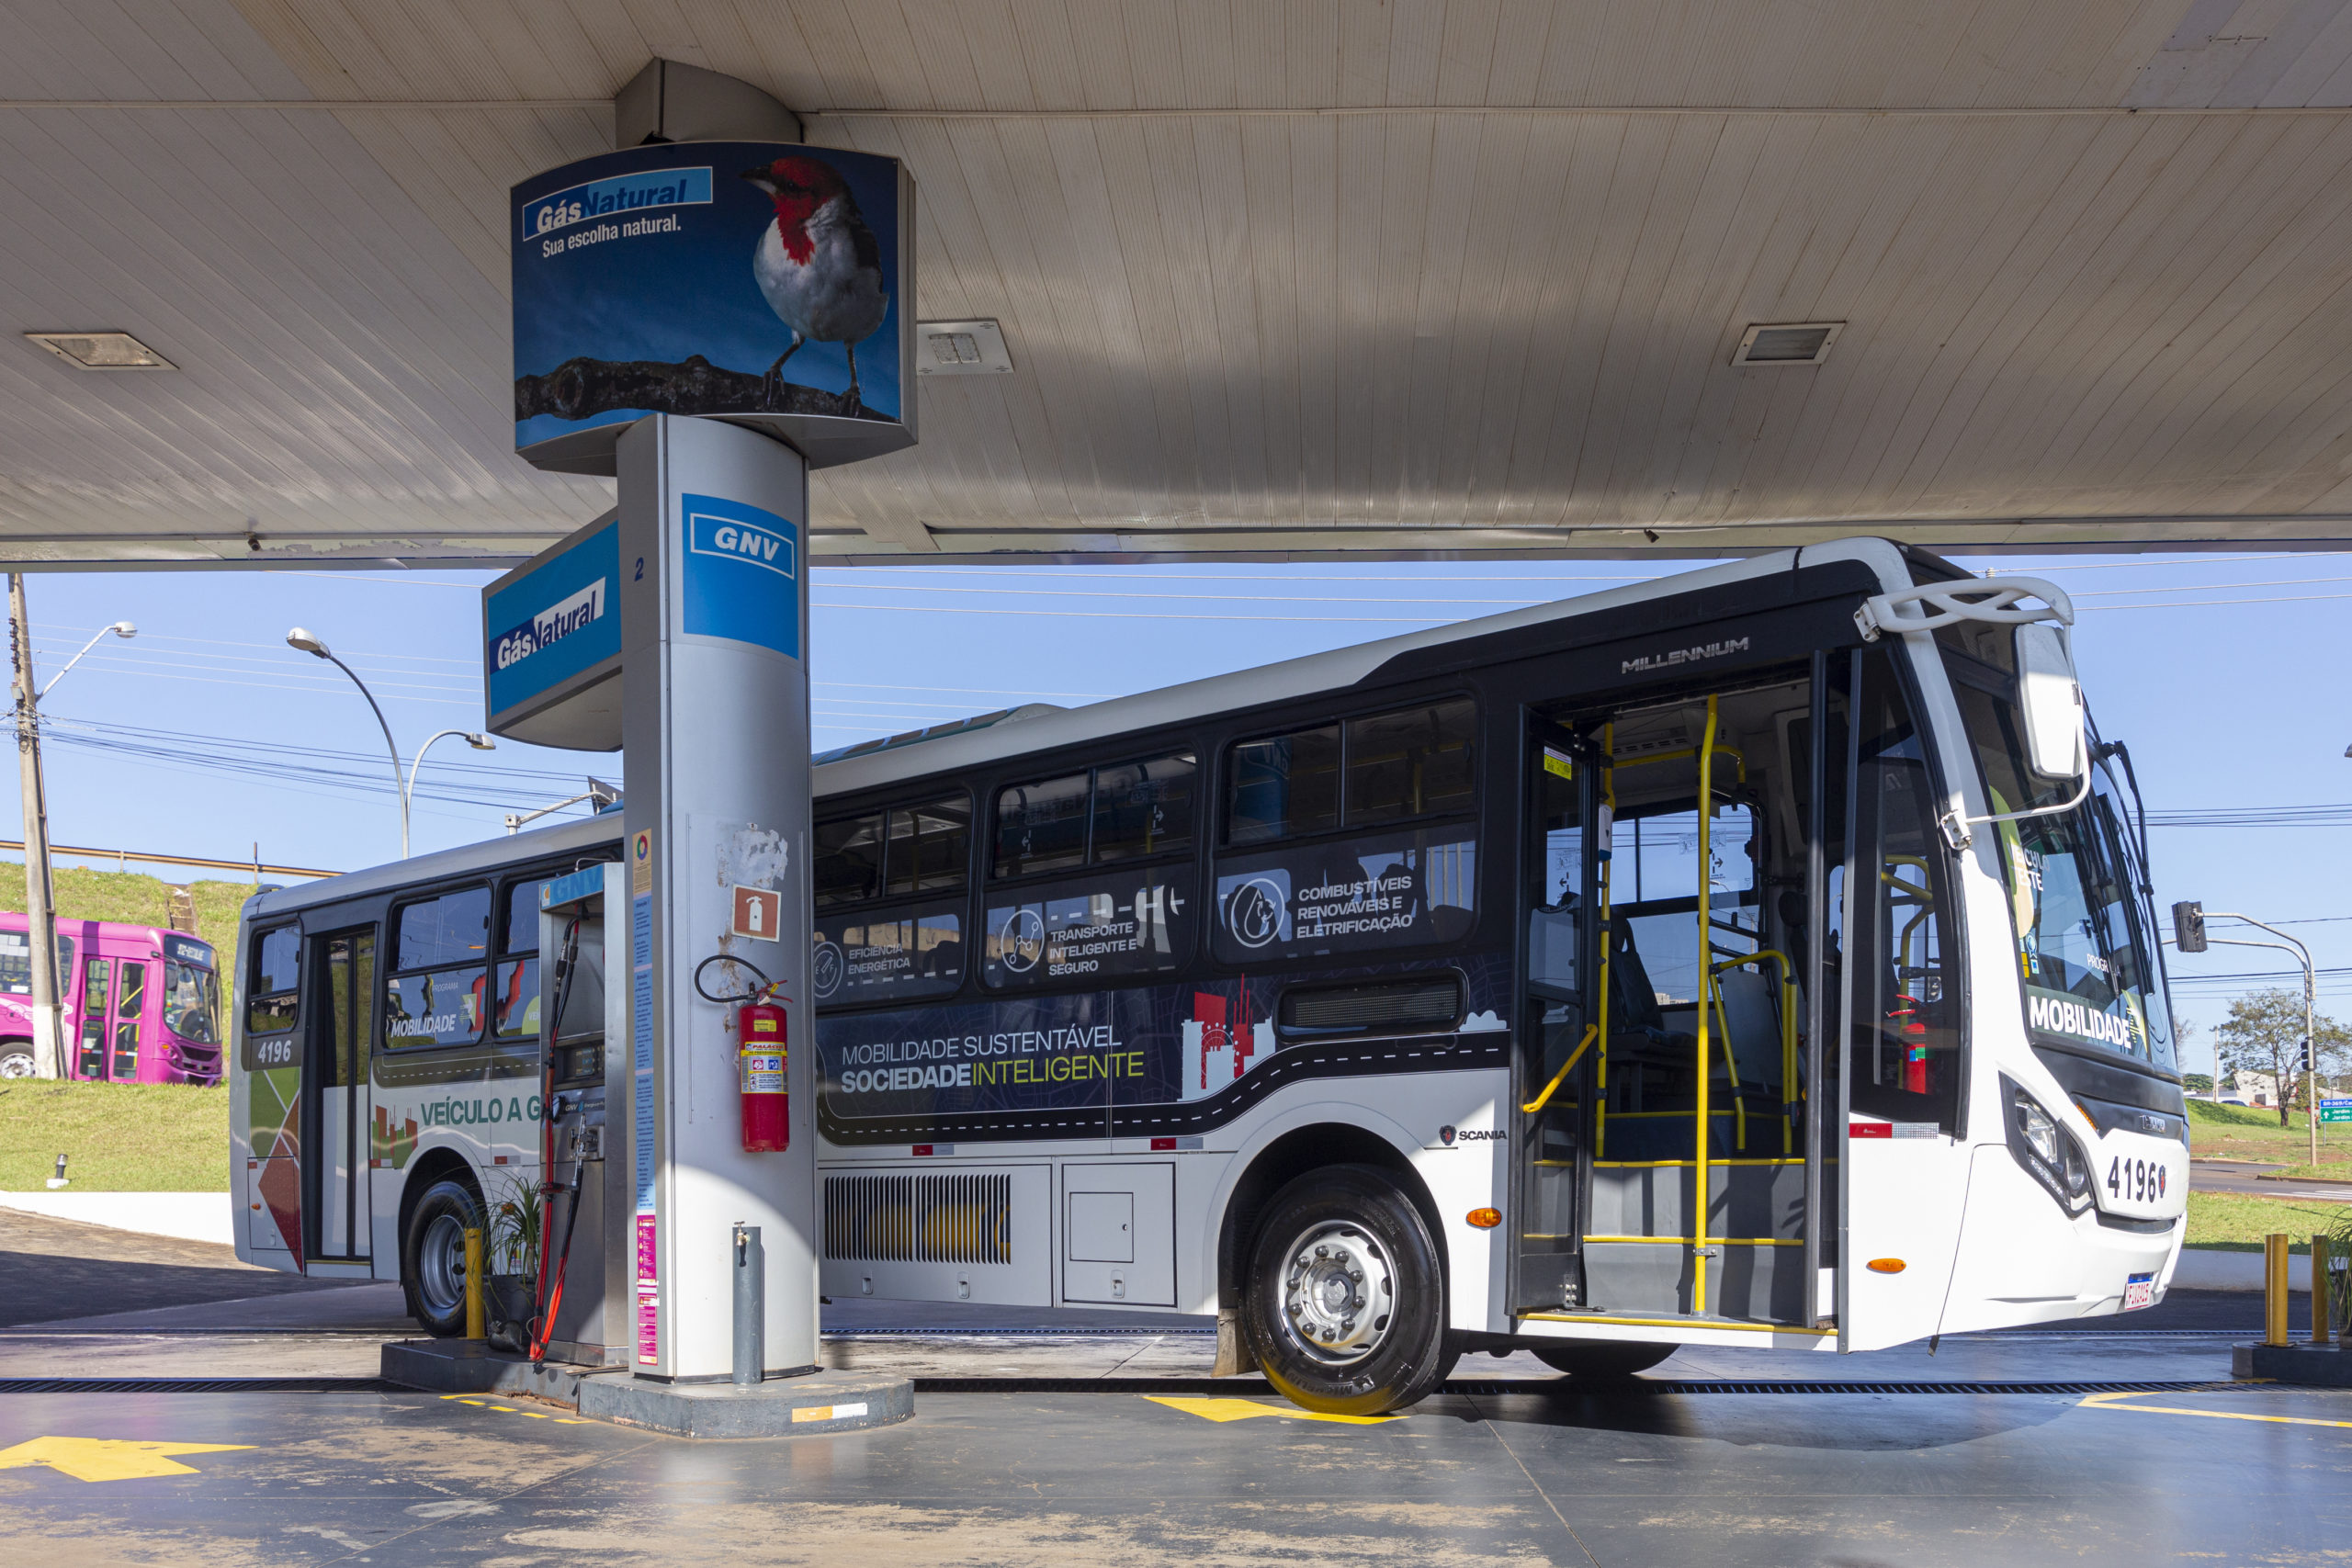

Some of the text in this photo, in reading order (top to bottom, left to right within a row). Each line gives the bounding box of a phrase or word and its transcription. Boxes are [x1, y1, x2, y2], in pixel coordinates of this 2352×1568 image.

[542, 214, 682, 258] Sua escolha natural.
[714, 526, 780, 561] GNV
[635, 557, 644, 582] 2
[1622, 637, 1749, 674] MILLENNIUM
[1298, 875, 1413, 902] COMBUSTÍVEIS
[1297, 897, 1402, 920] RENOVÁVEIS E
[1050, 921, 1134, 942] TRANSPORTE
[1296, 914, 1413, 939] ELETRIFICAÇÃO
[848, 942, 903, 960] EFICIÊNCIA
[1049, 939, 1136, 960] INTELIGENTE E
[848, 956, 910, 976] ENERGÉTICA
[1048, 960, 1099, 976] SEGURO
[2086, 953, 2121, 978] PROGRA
[390, 1014, 457, 1038] MOBILIDADE
[2029, 995, 2132, 1050] MOBILIDADE
[258, 1039, 292, 1064] 4196
[842, 1022, 1123, 1066] MOBILIDADE SUSTENTÁVEL
[421, 1096, 503, 1126] VEÍCULO
[506, 1097, 523, 1122] A
[1458, 1130, 1508, 1141] SCANIA
[2108, 1156, 2157, 1203] 4196
